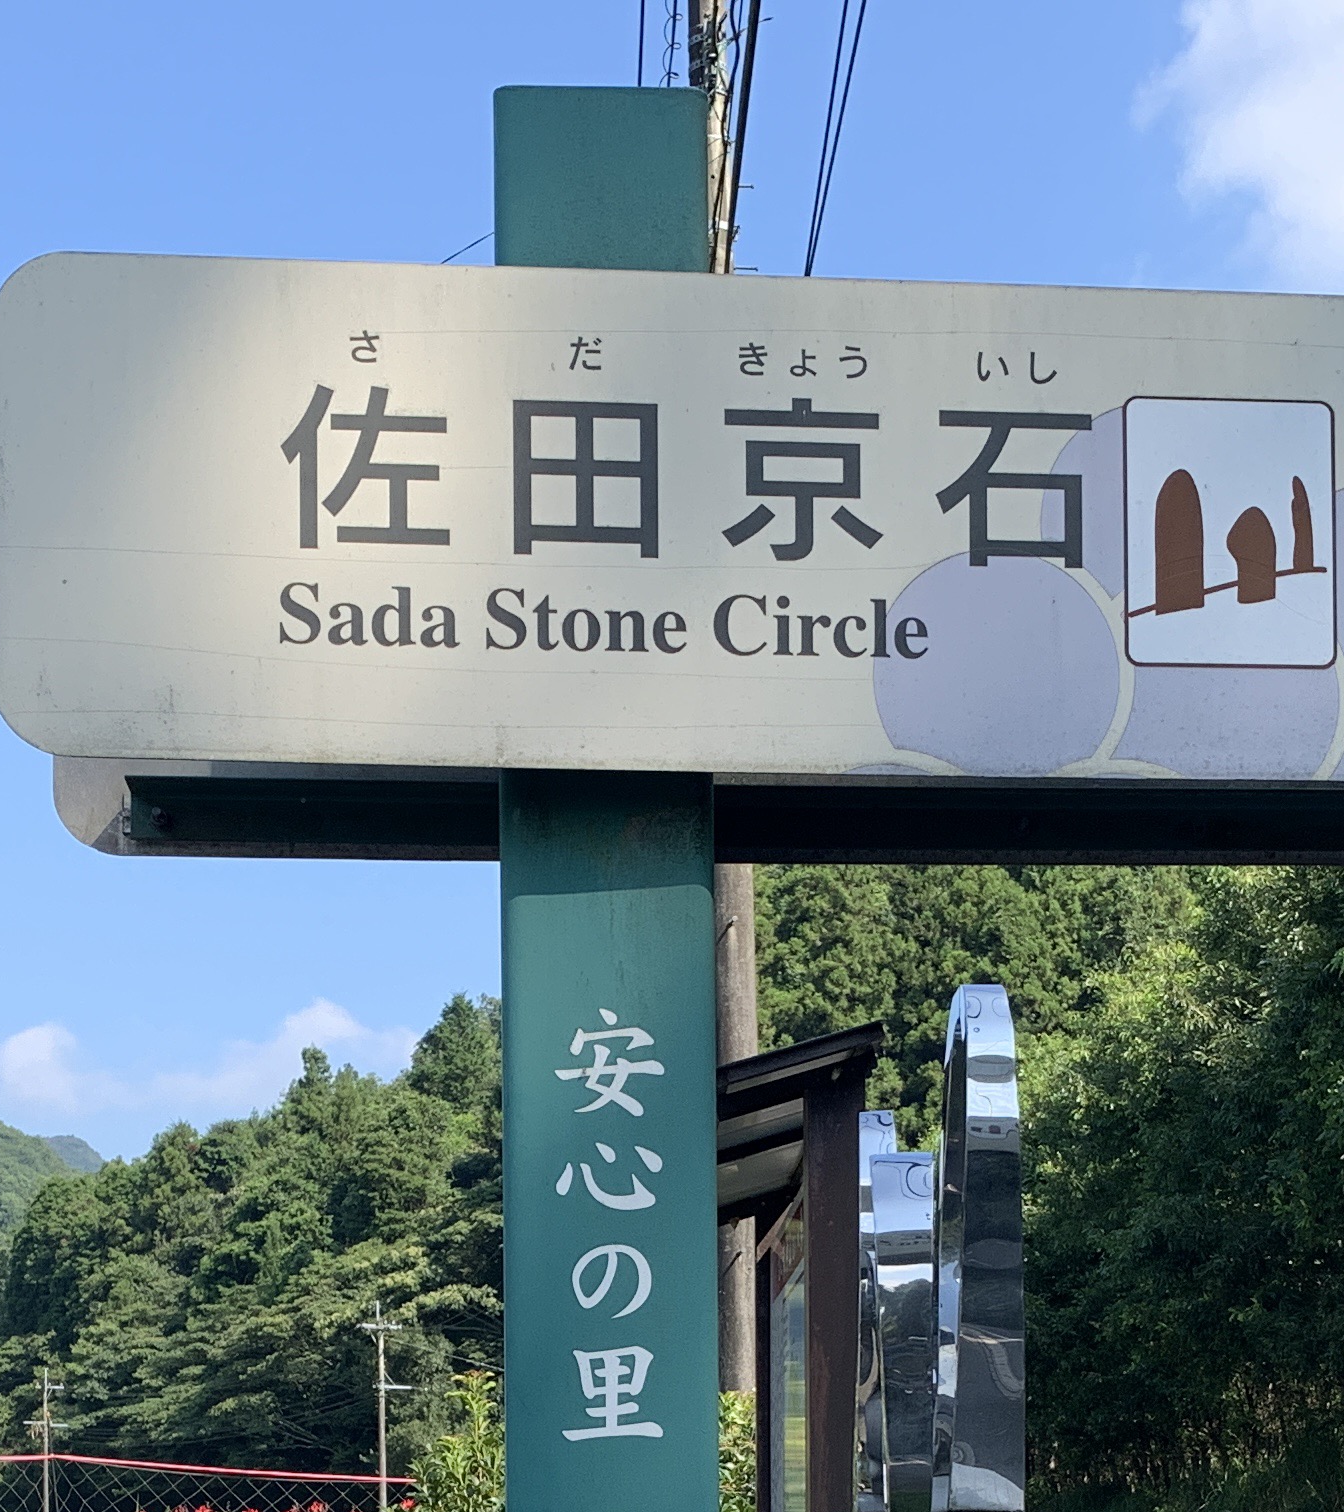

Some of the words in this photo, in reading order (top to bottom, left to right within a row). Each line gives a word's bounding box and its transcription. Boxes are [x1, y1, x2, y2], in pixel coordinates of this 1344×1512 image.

[348, 329, 382, 364] さ
[568, 334, 604, 371] だ
[737, 341, 872, 380] きょう
[975, 350, 1060, 386] いし
[280, 384, 1095, 569] 佐田京石
[278, 582, 462, 649] Sada
[485, 588, 689, 655] Stone
[712, 594, 931, 661] Circle
